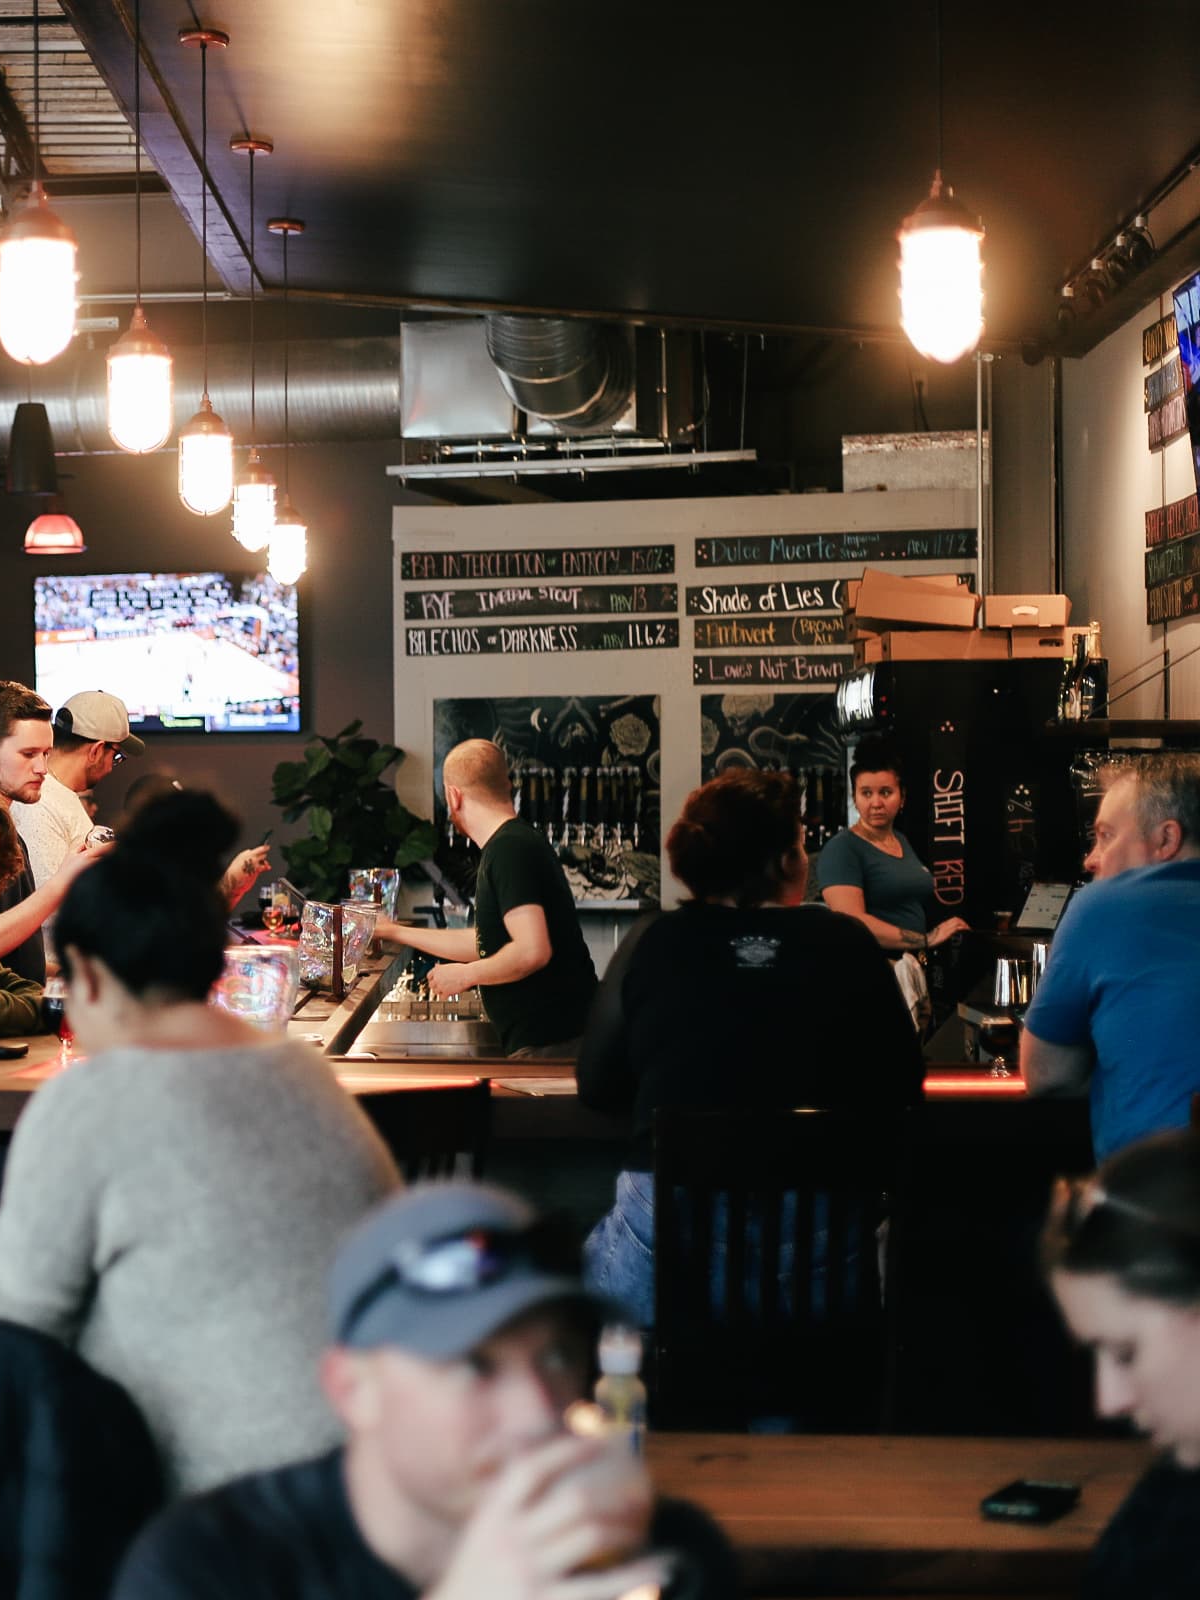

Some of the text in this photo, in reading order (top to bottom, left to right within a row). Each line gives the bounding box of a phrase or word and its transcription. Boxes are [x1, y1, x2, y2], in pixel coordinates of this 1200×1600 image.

[770, 536, 837, 562] Muerte
[421, 591, 455, 619] RYE
[538, 587, 582, 611] STOUT
[700, 585, 752, 614] Shade
[759, 584, 778, 611] of
[781, 582, 824, 610] Lies
[500, 624, 577, 653] DARKNESS
[705, 619, 776, 647] Ambivert
[760, 657, 788, 680] Nut
[792, 656, 843, 681] Brown
[933, 769, 965, 905] SHIFT RED
